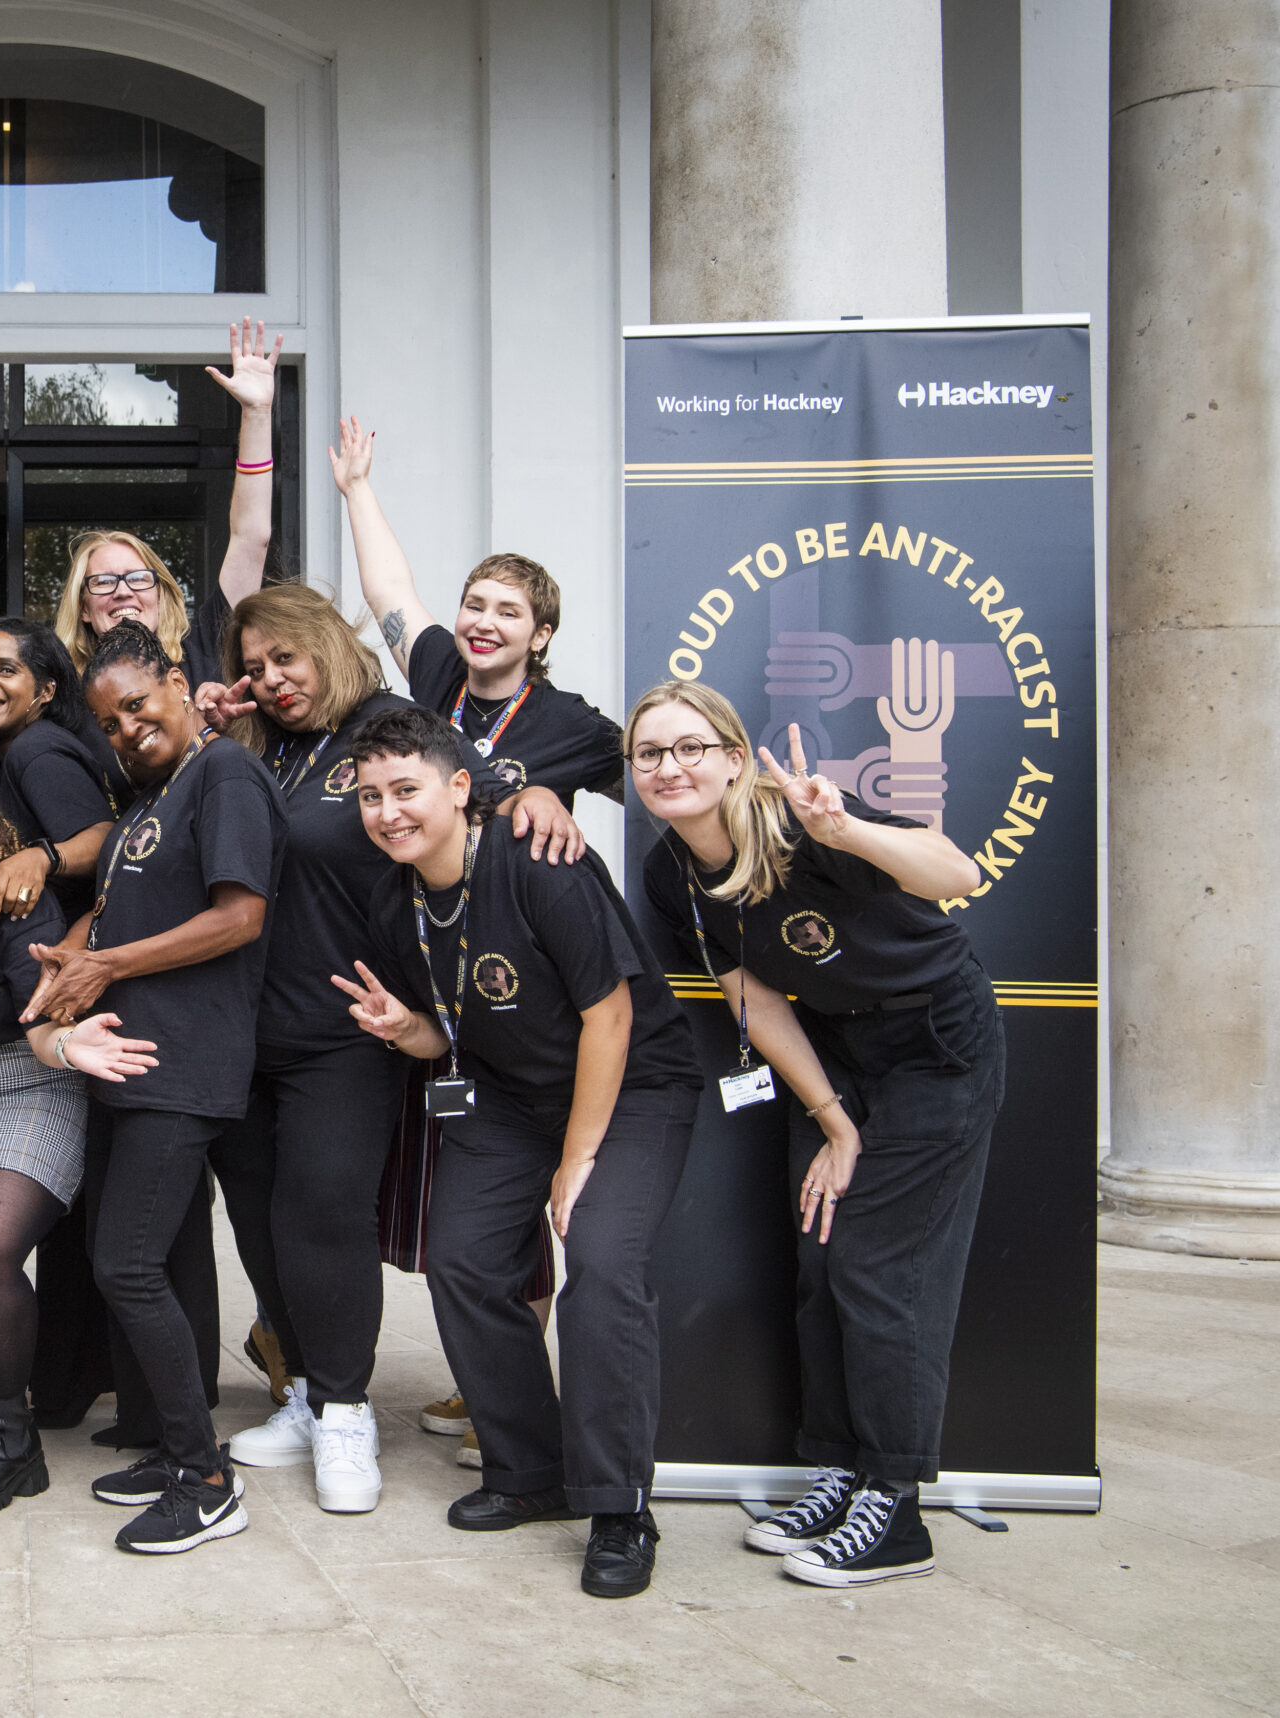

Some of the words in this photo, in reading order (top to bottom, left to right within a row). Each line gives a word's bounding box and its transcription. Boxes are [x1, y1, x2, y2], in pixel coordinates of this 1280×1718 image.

[657, 396, 730, 416] Working
[736, 394, 759, 411] for
[763, 393, 844, 414] Hackney
[928, 380, 1054, 408] Hackney
[669, 588, 734, 681] OUD
[728, 543, 788, 592] TO
[795, 522, 850, 565] BE
[859, 522, 1059, 738] ANTI-RACIST
